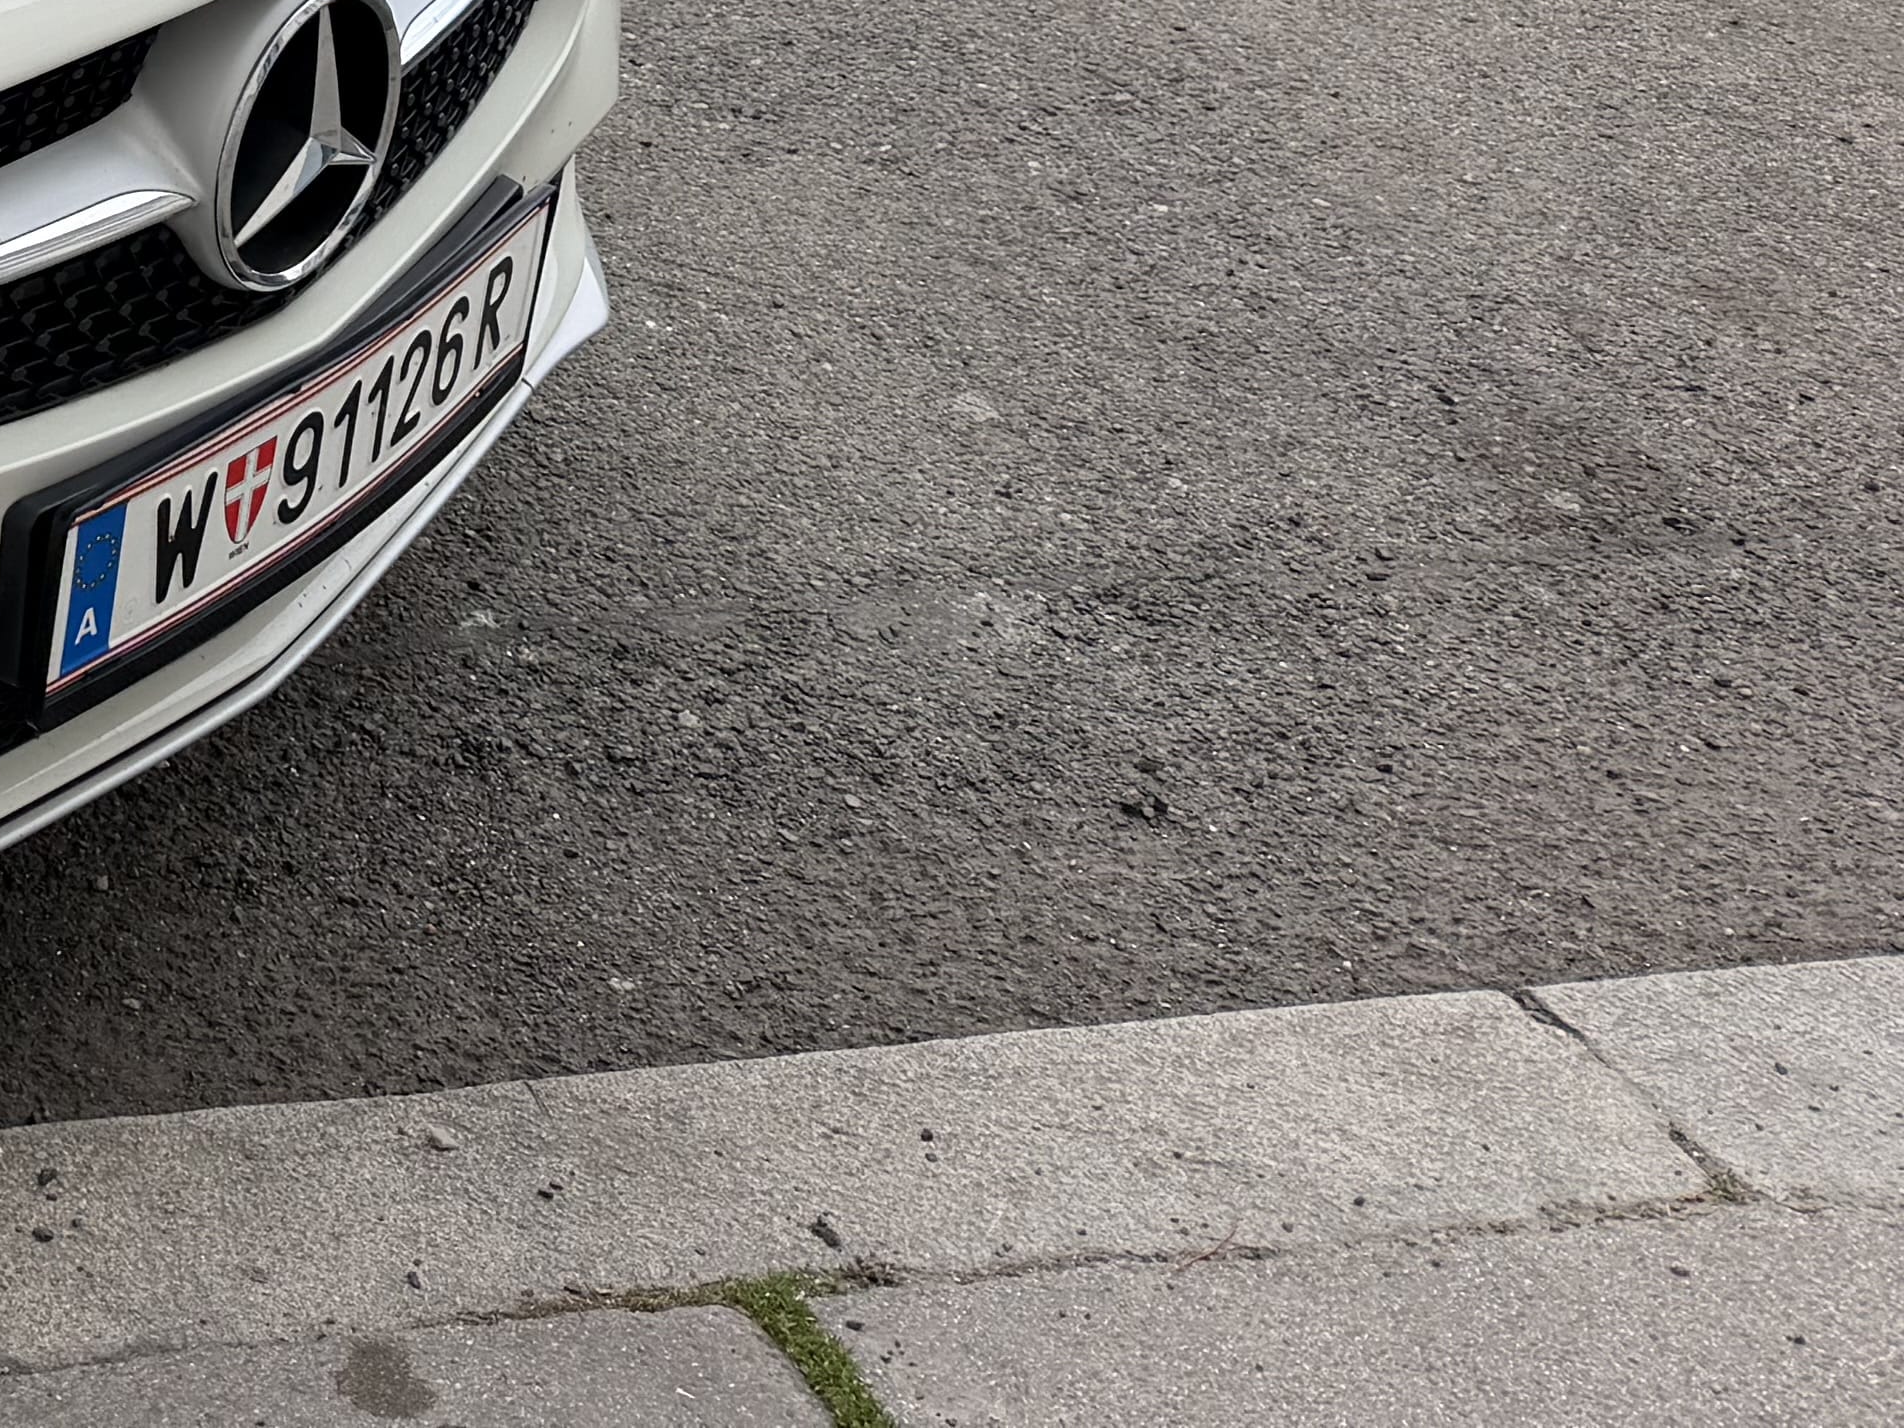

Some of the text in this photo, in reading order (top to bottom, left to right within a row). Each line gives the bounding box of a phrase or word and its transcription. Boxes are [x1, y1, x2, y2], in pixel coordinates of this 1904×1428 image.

[74, 255, 514, 646] A W 91126 R
